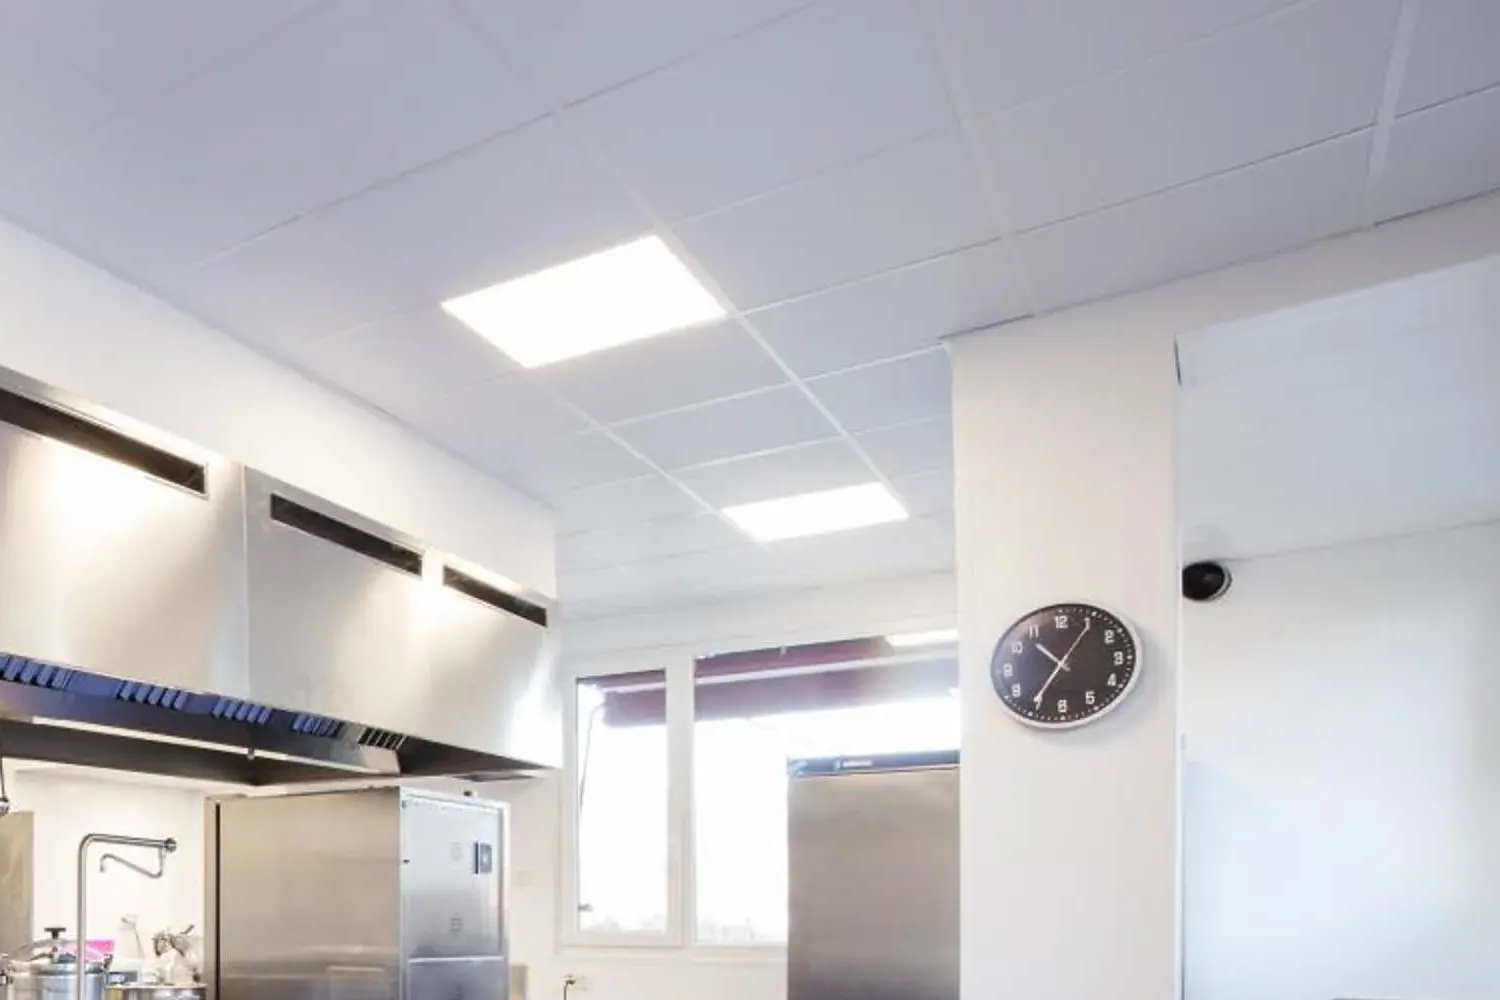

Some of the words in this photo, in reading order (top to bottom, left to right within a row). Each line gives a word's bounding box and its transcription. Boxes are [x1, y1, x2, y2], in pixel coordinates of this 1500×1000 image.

[1055, 615, 1068, 629] 12
[1030, 624, 1040, 638] 11
[1105, 630, 1115, 644] 2
[1113, 651, 1123, 665] 3
[1108, 673, 1117, 686] 4
[1085, 691, 1096, 704] 5
